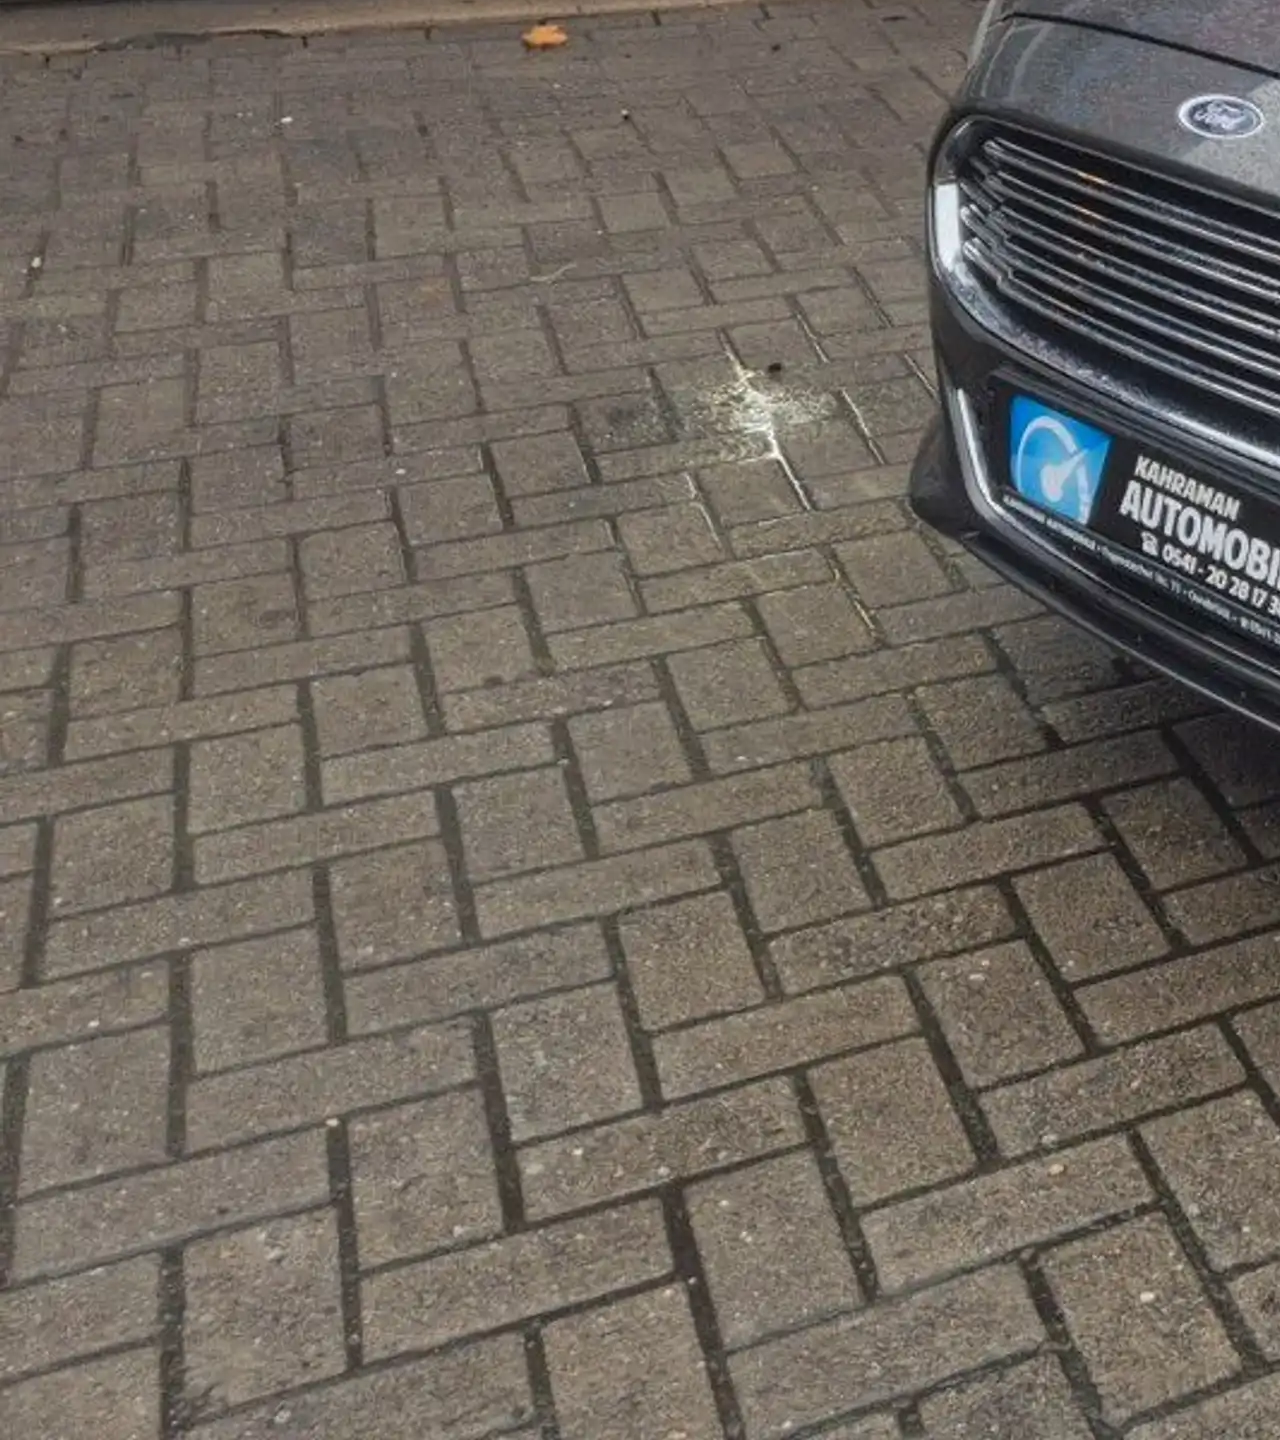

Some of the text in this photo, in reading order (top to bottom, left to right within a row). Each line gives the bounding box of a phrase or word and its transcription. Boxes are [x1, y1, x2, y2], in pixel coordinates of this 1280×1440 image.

[1134, 455, 1242, 521] KAHRAMAN
[1162, 539, 1198, 575] 0541
[1204, 566, 1228, 590] 20
[1229, 574, 1250, 601] 28
[1251, 586, 1270, 609] 17
